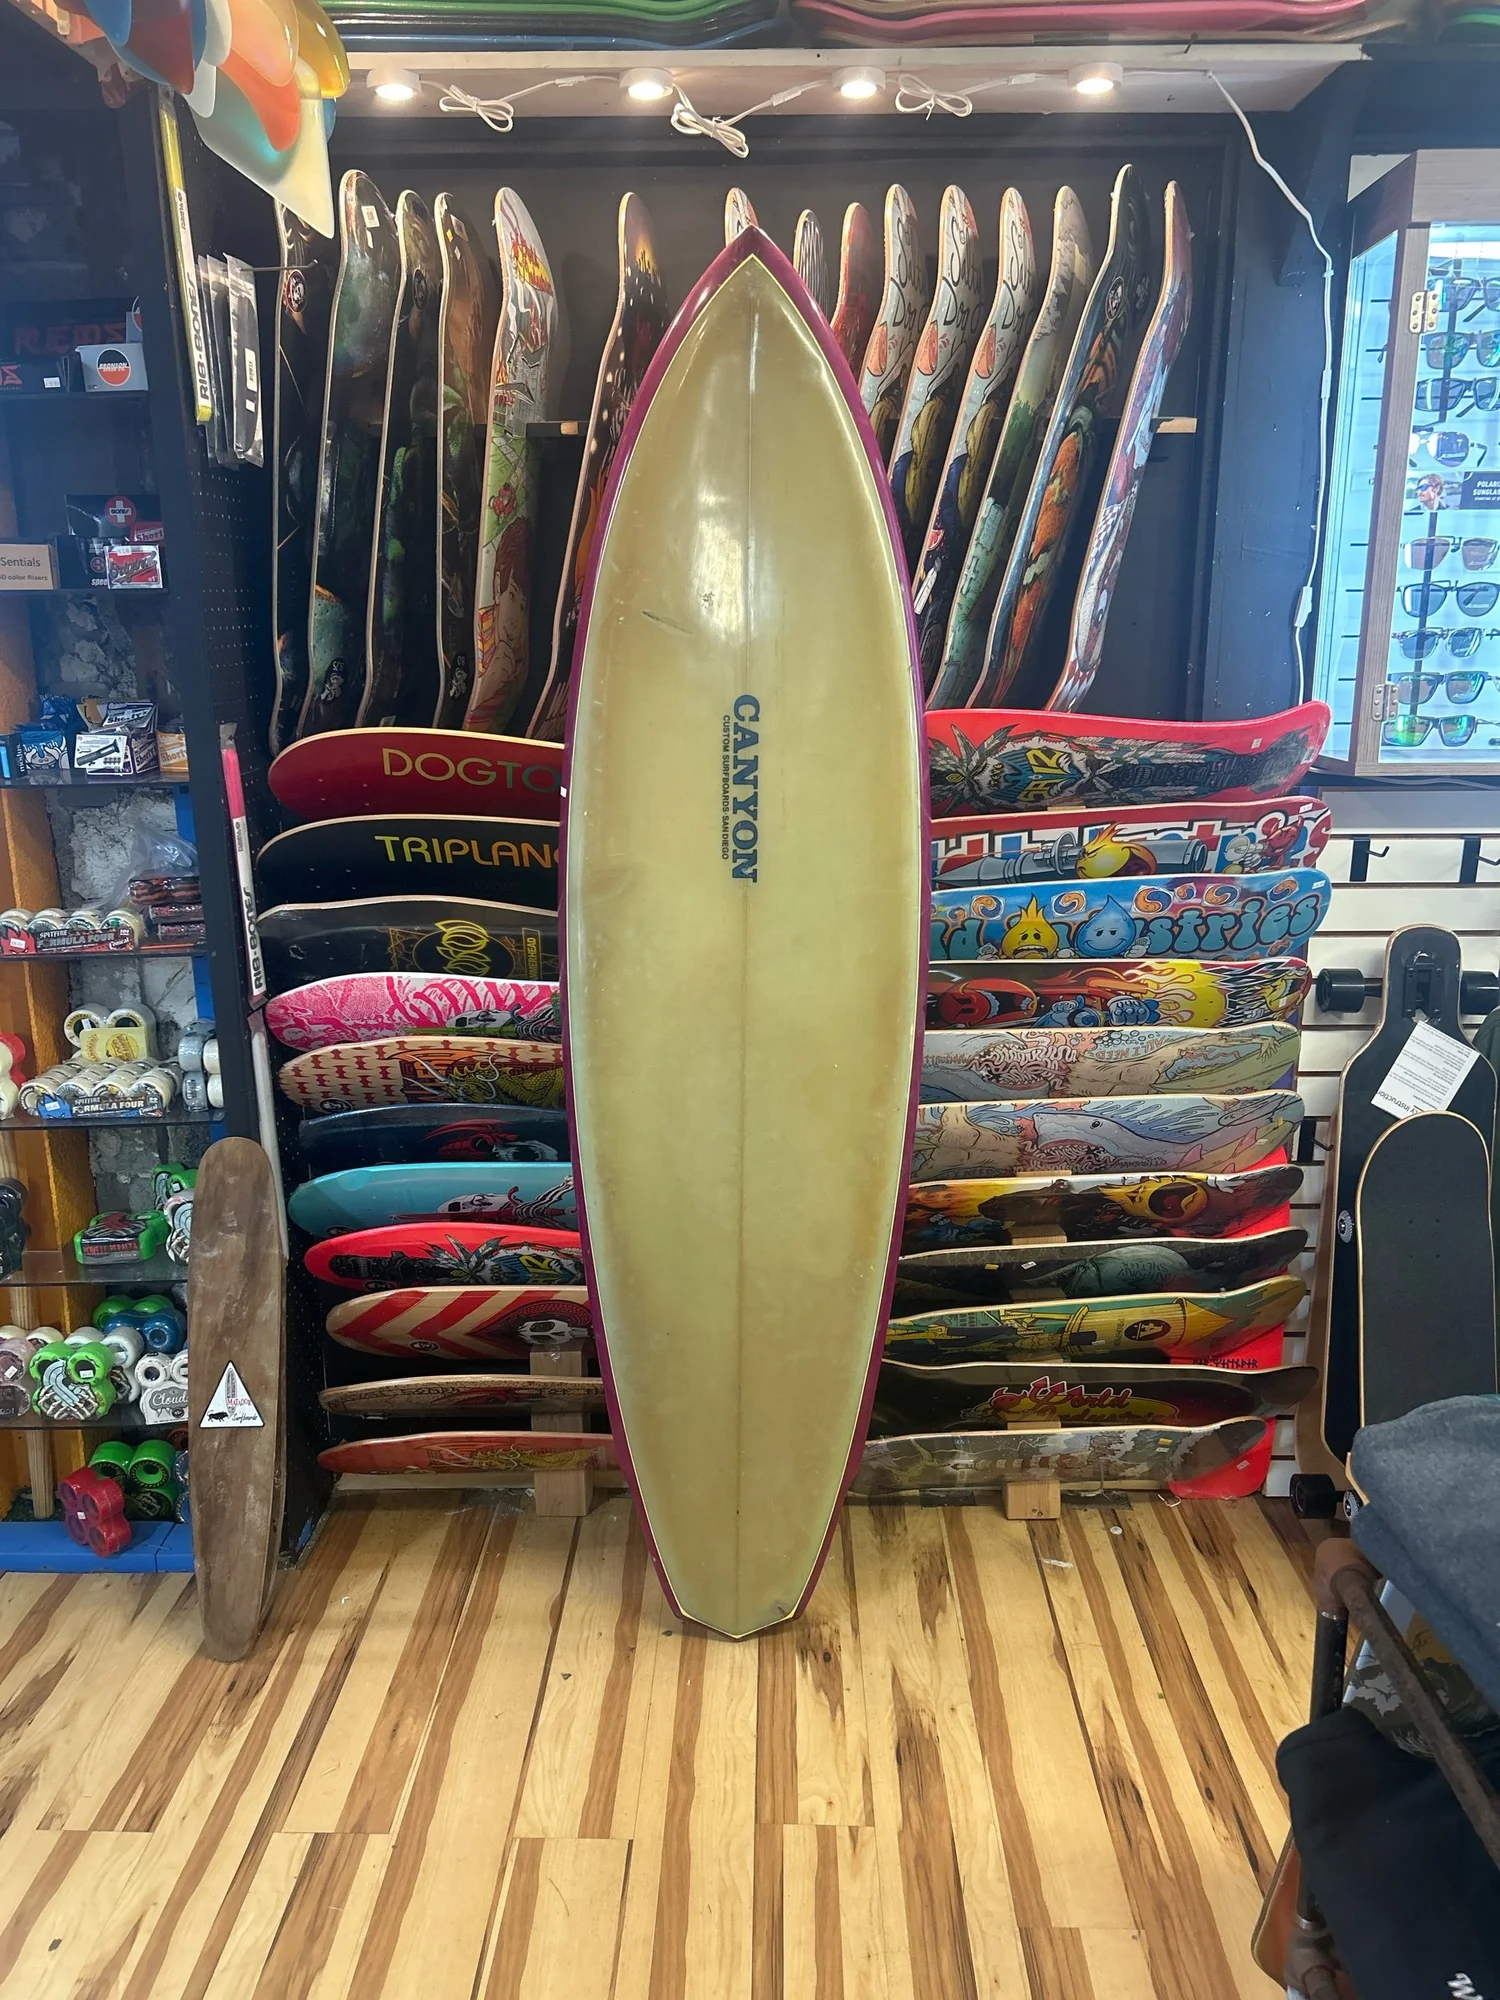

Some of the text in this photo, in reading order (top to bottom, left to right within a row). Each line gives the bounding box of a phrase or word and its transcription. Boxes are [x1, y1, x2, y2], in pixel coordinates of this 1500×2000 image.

[722, 714, 731, 752] CUSTOM
[16, 743, 26, 772] modus
[732, 694, 760, 883] CANYON
[721, 815, 730, 833] SAN
[721, 833, 730, 860] DIEGO
[39, 930, 68, 939] SPITFIRE
[88, 932, 115, 945] FOUR
[1095, 1047, 1130, 1060] NEED
[74, 1097, 101, 1105] SPITFIRE
[119, 1100, 144, 1109] FOUR
[1029, 1375, 1133, 1410] World
[226, 1397, 252, 1407] MATADOR
[231, 1412, 258, 1425] Surfboards
